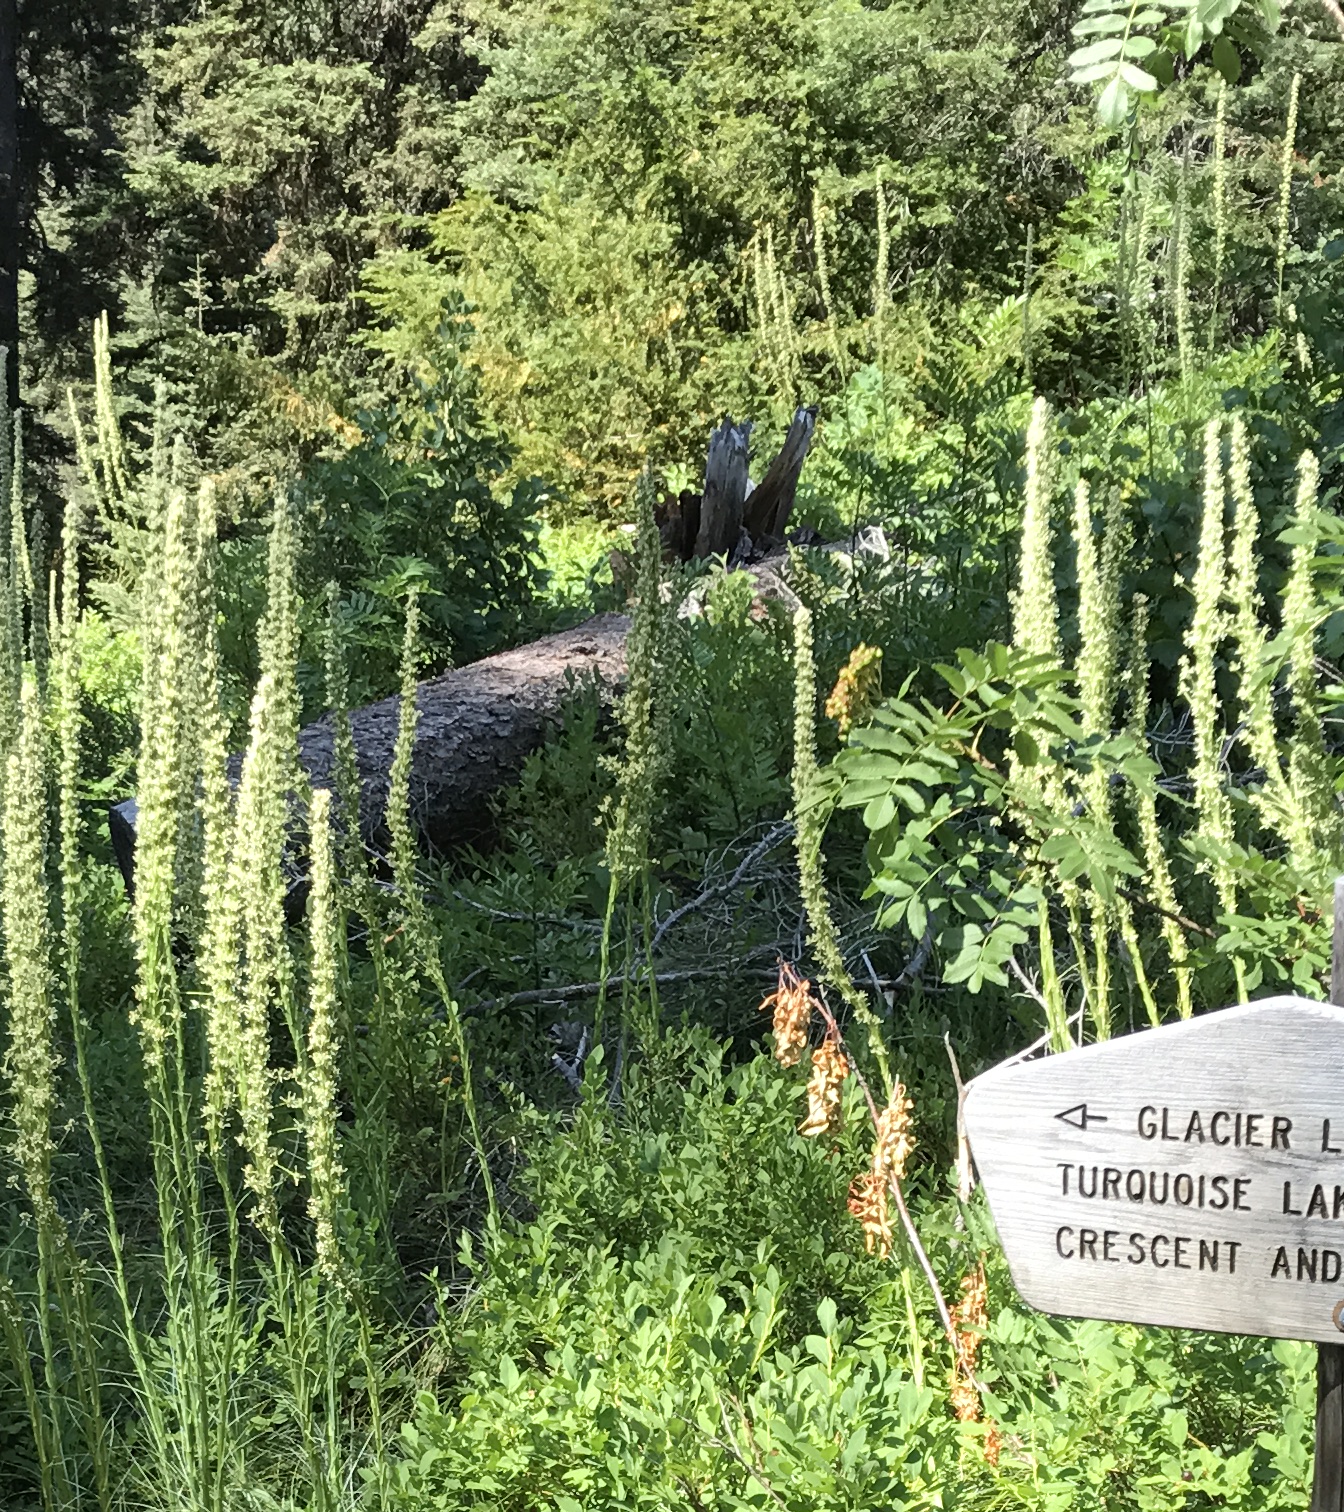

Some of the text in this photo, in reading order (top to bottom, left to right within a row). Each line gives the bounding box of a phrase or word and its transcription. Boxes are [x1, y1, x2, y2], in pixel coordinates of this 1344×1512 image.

[1137, 1105, 1293, 1151] GLACIER
[1057, 1163, 1252, 1211] TURQUOISE
[1056, 1226, 1241, 1275] CRESCENT
[1270, 1245, 1342, 1283] AND
